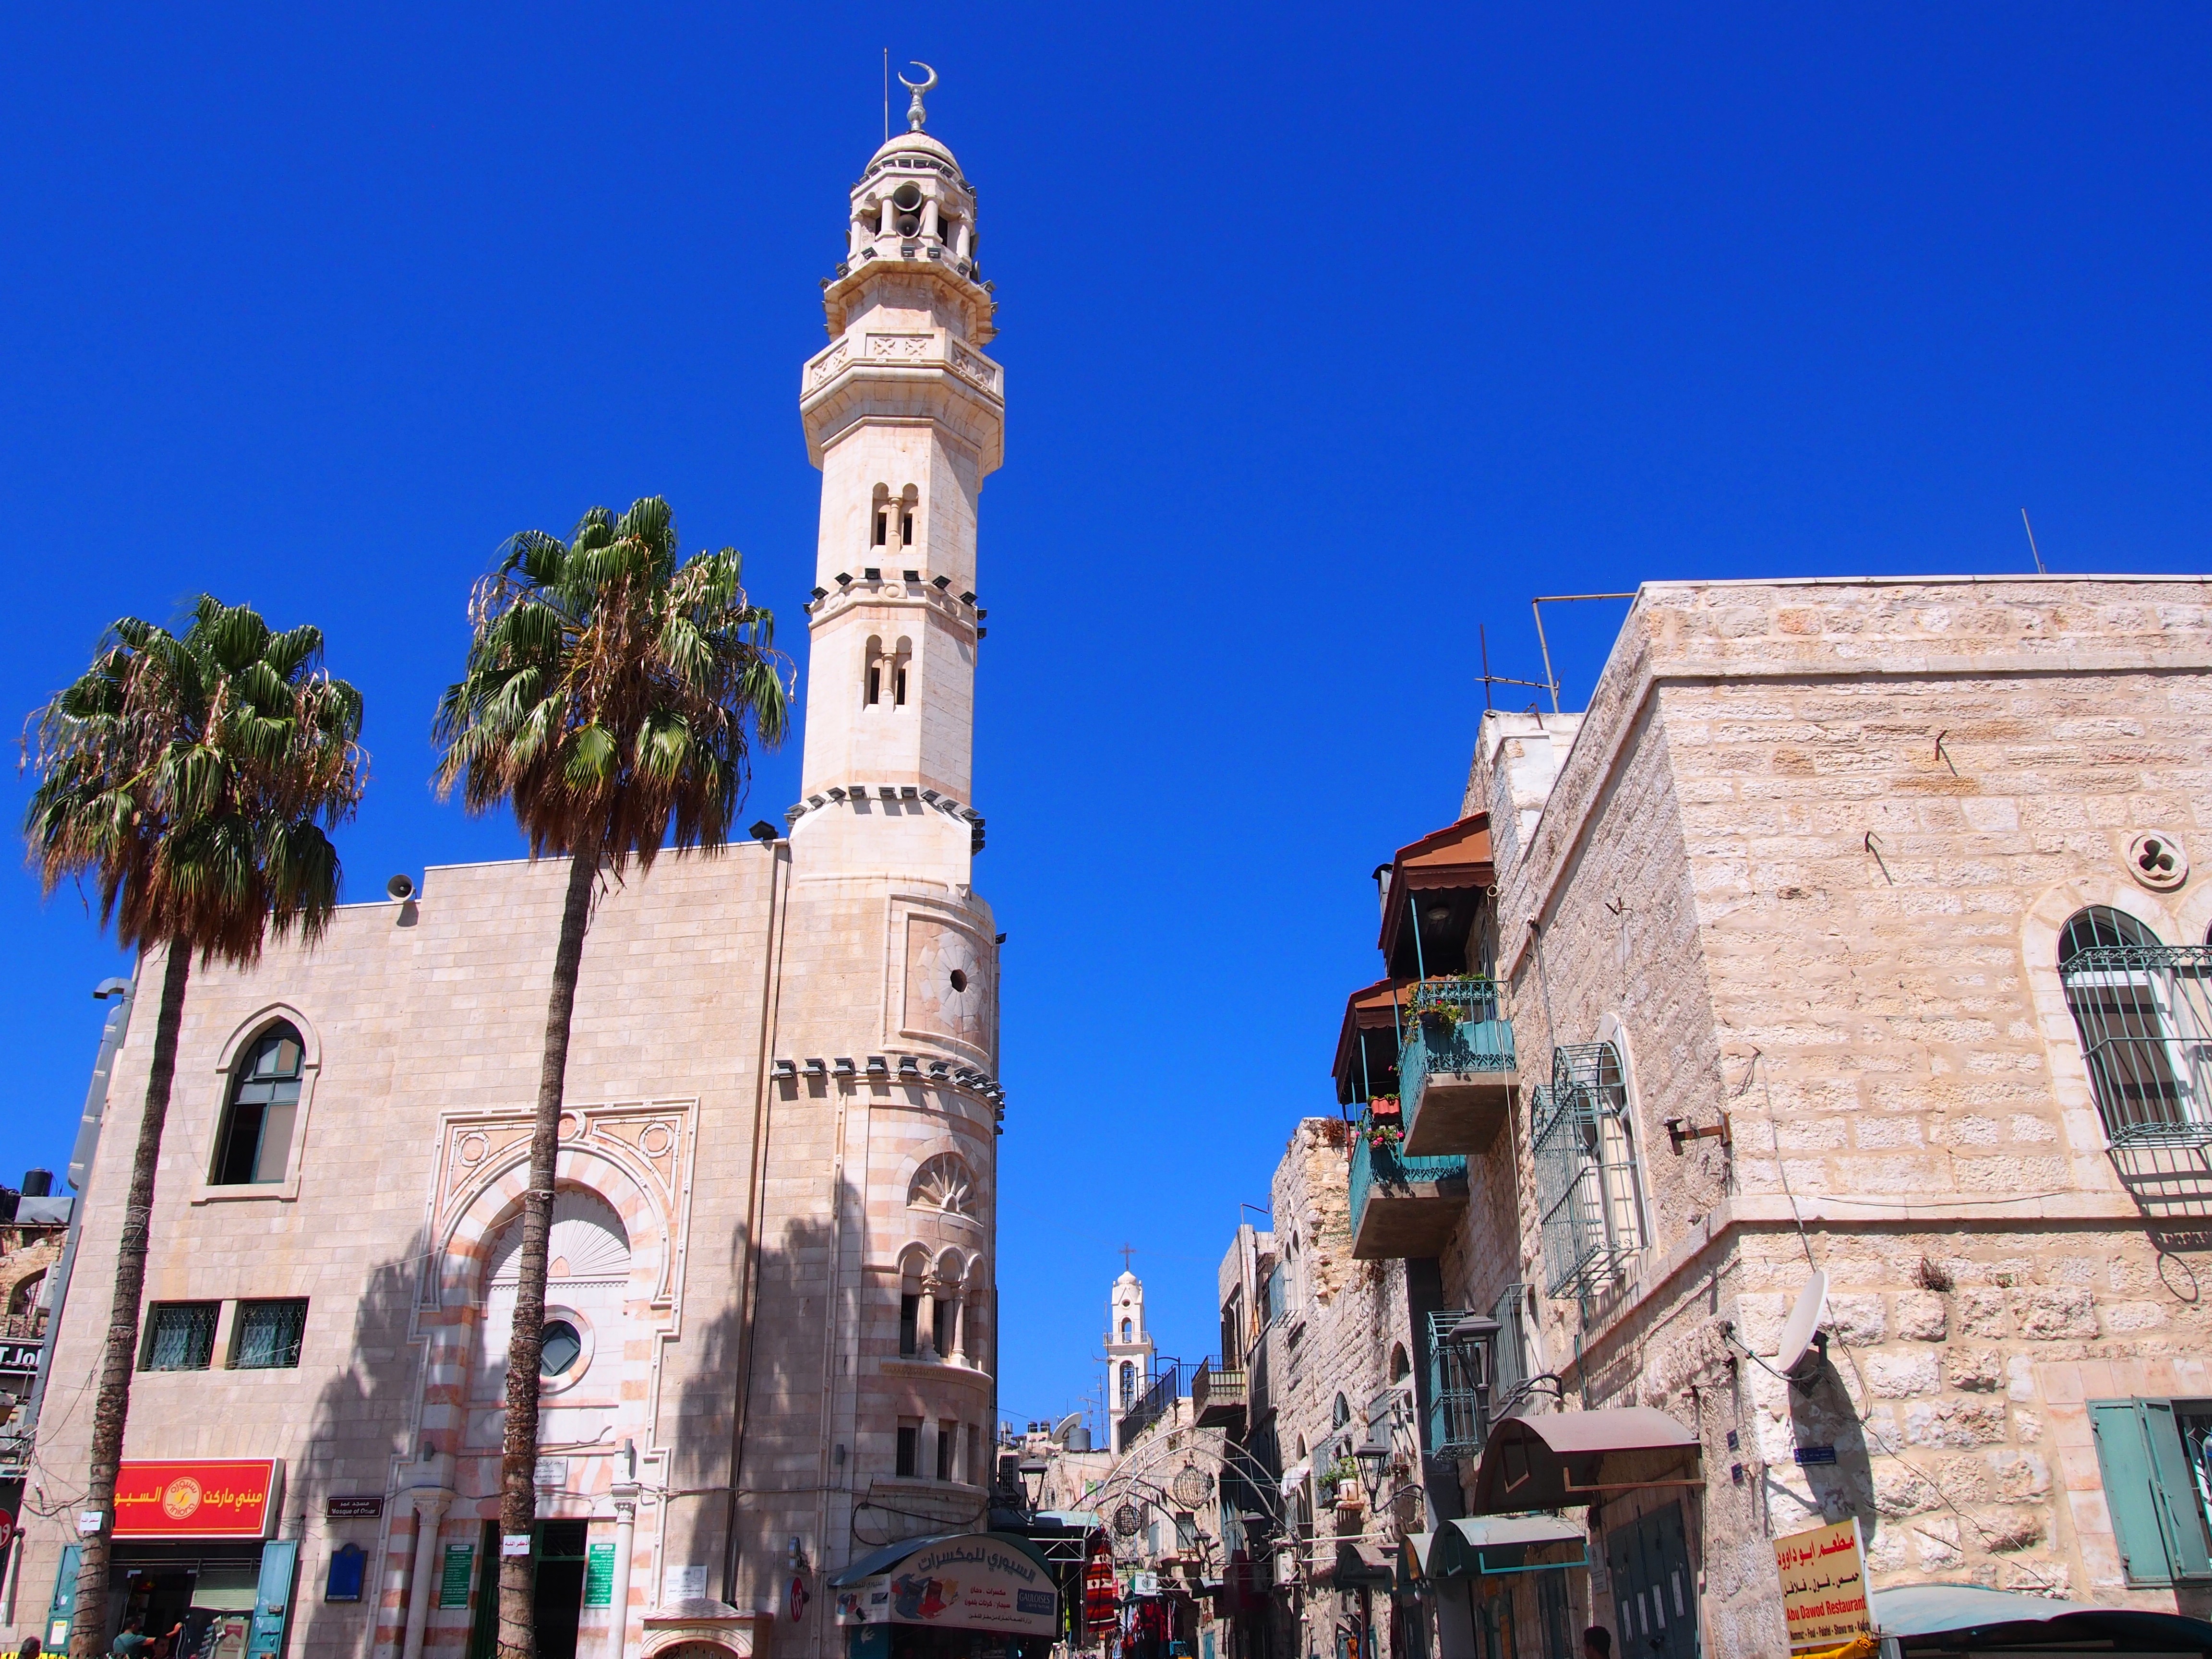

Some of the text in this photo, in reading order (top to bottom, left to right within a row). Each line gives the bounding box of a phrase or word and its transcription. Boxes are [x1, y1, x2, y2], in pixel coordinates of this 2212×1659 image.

[114, 1486, 262, 1512] ميني ماركت السيو
[1777, 1532, 1854, 1571] مطعم ابو داوود
[918, 1546, 1036, 1584] السيوري للمكسرات
[986, 1588, 1006, 1596] مكسرات
[1784, 1578, 1807, 1598] فلافل
[1813, 1573, 1830, 1593] فول
[1019, 1592, 1050, 1604] GAULOISES
[1786, 1595, 1867, 1622] Abu Dawod Restaurant
